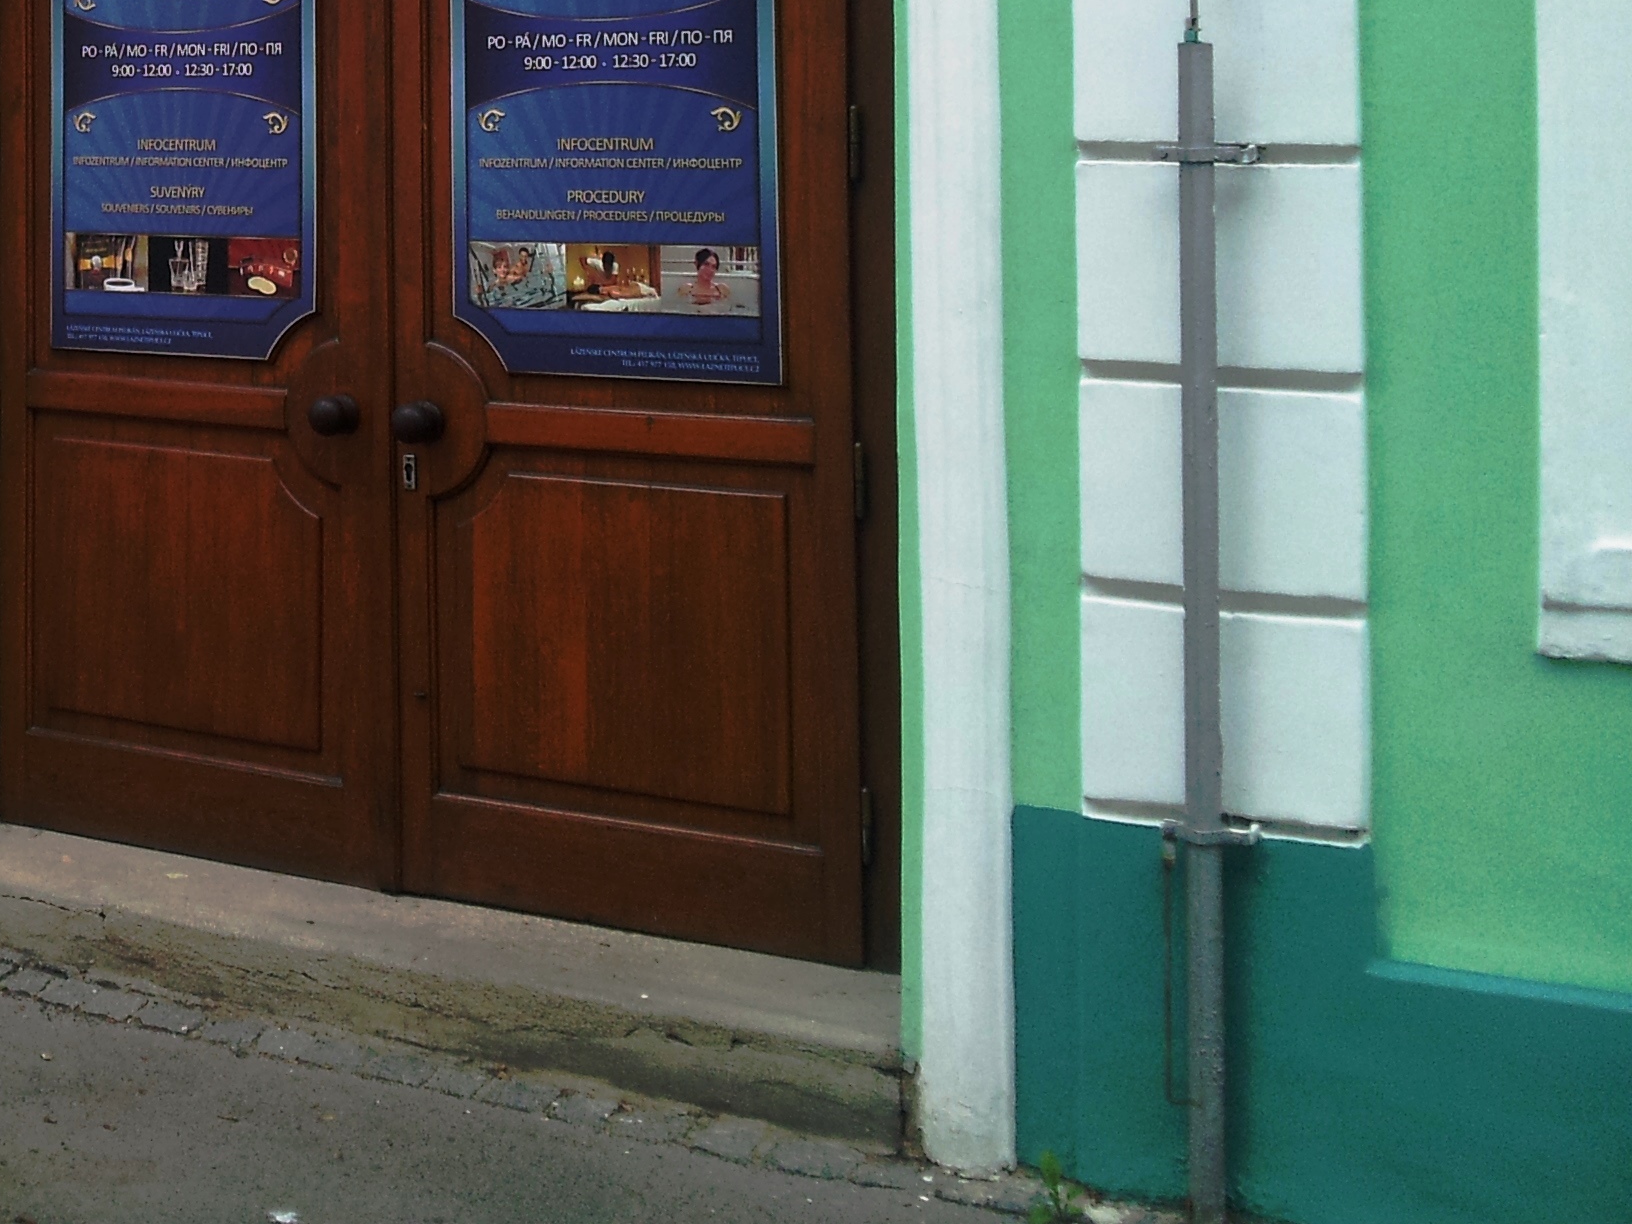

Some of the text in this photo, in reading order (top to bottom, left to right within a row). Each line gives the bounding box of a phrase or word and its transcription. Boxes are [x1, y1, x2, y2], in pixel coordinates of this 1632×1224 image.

[487, 35, 506, 49] PO
[515, 32, 531, 49] PÁ
[541, 34, 566, 48] MO
[575, 33, 592, 47] FR
[603, 32, 638, 46] MON
[648, 31, 669, 45] FRI
[81, 45, 97, 58] PO
[104, 43, 118, 57] PÁ
[126, 45, 147, 57] MO
[154, 44, 168, 57] FR
[177, 44, 206, 57] MON
[213, 43, 230, 56] FRI
[524, 56, 552, 70] 9:00
[561, 55, 597, 69] 12:00
[612, 54, 649, 69] 12:30
[659, 53, 697, 68] 17:00
[111, 64, 135, 77] 9:00
[142, 64, 172, 77] 12:00
[184, 63, 214, 76] 12:30
[222, 63, 253, 76] 17:00
[137, 138, 216, 151] INFOCENTRUM
[557, 137, 654, 151] INFOCENTRUM
[193, 157, 224, 168] CENTER
[479, 158, 548, 168] INFOZENTRUM
[555, 158, 624, 169] INFORMATION
[626, 158, 664, 169] CENTER
[149, 184, 205, 199] SUVENÝRY
[567, 190, 645, 204] PROCEDURY
[495, 209, 575, 221] BEHANDLUNGEN
[583, 210, 648, 221] PROCEDURES
